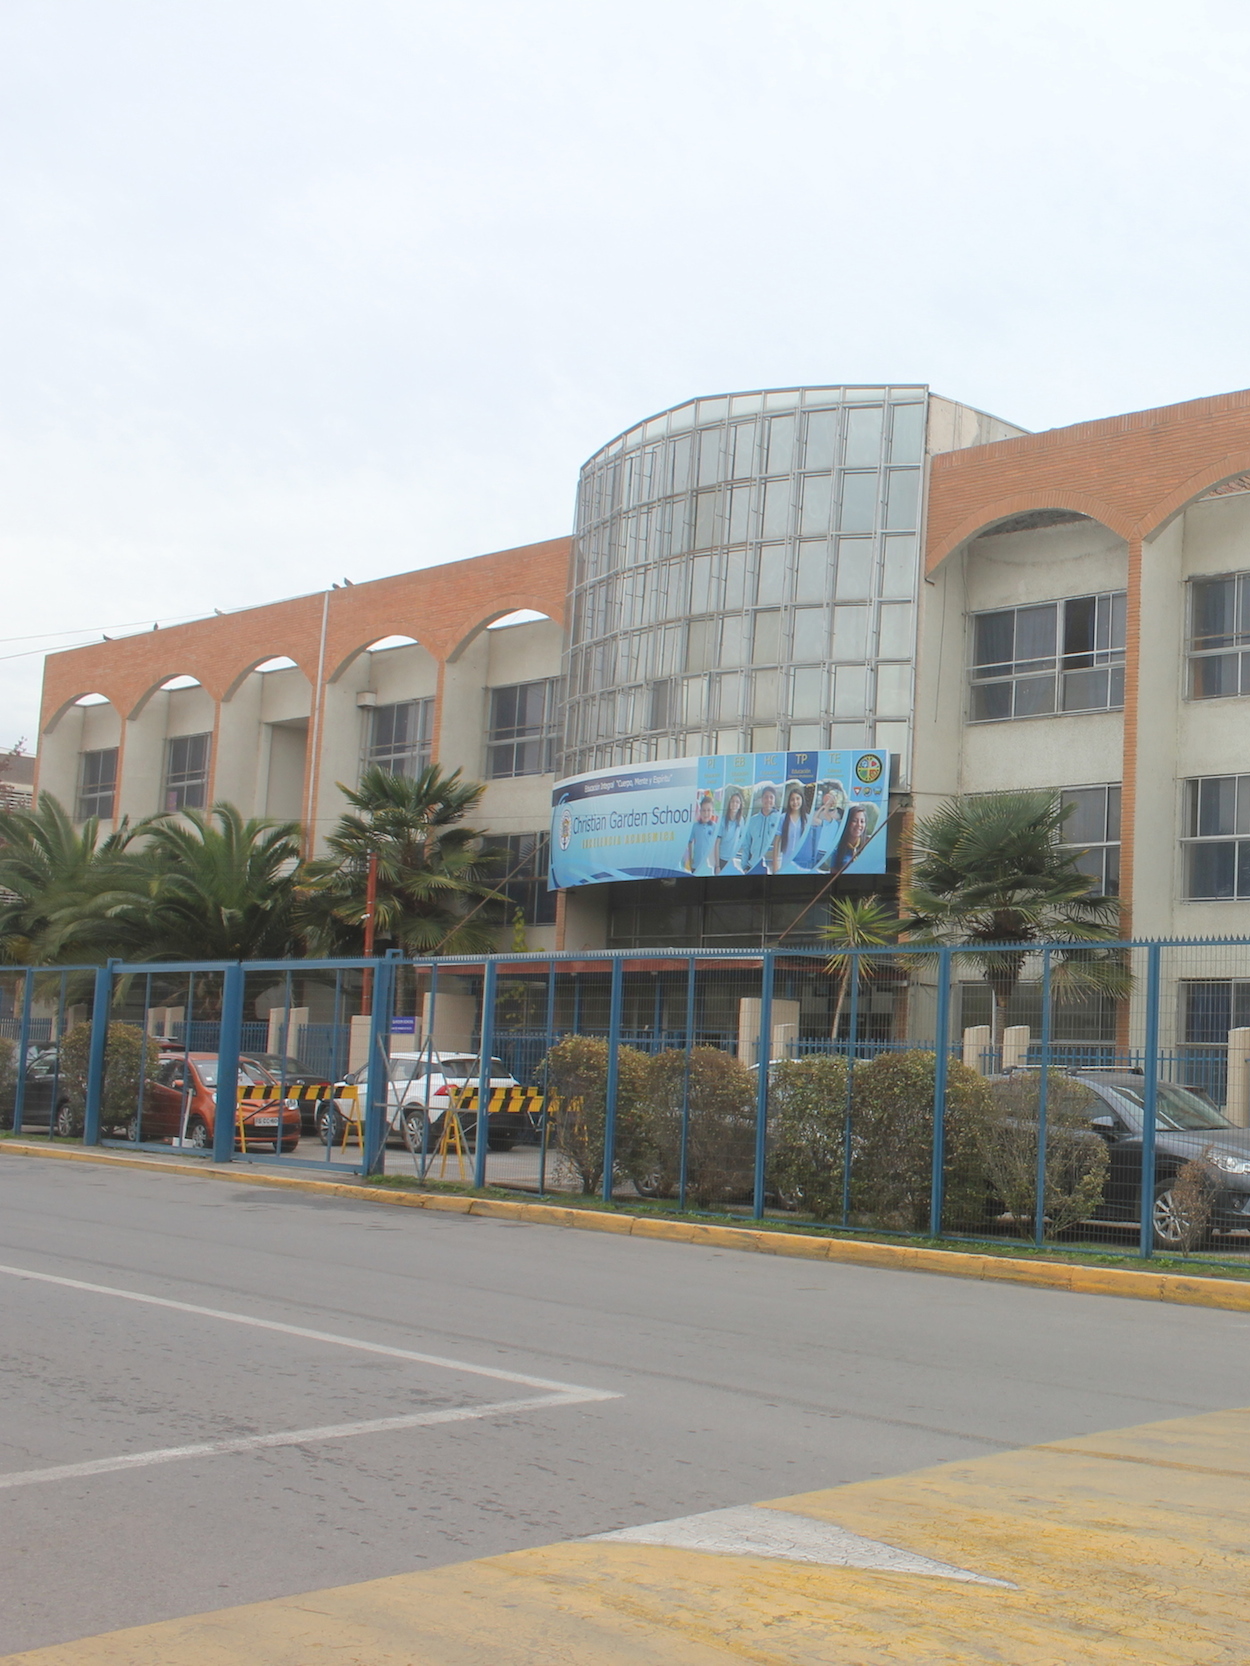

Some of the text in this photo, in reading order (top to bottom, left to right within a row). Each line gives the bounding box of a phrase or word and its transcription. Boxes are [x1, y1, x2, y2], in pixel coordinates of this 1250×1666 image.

[707, 758, 716, 769] PI
[734, 756, 746, 767] EB
[763, 755, 778, 766] HC
[795, 753, 809, 765] TP
[828, 753, 842, 764] TE
[635, 777, 648, 786] Mente
[573, 803, 693, 834] Christian Garden School
